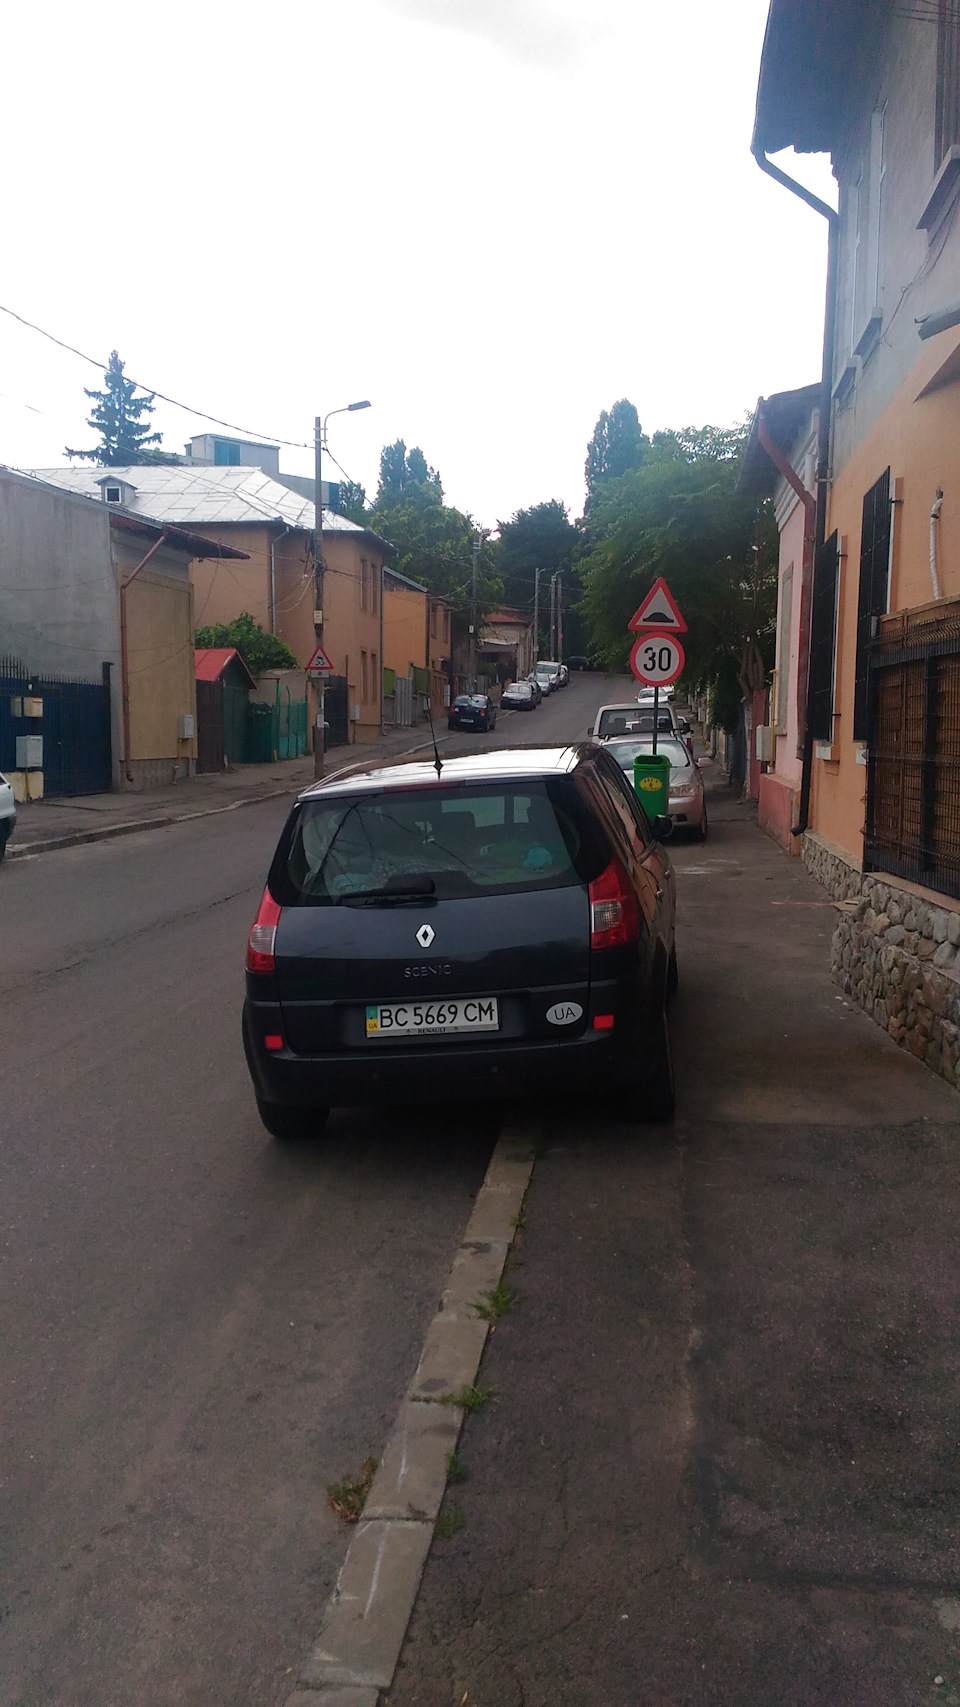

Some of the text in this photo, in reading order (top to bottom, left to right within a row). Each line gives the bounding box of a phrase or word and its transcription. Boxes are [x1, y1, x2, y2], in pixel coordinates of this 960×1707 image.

[643, 646, 672, 672] 30
[404, 963, 452, 978] SCENIC
[380, 1001, 494, 1029] BC 5669 CM
[554, 1006, 576, 1020] UA
